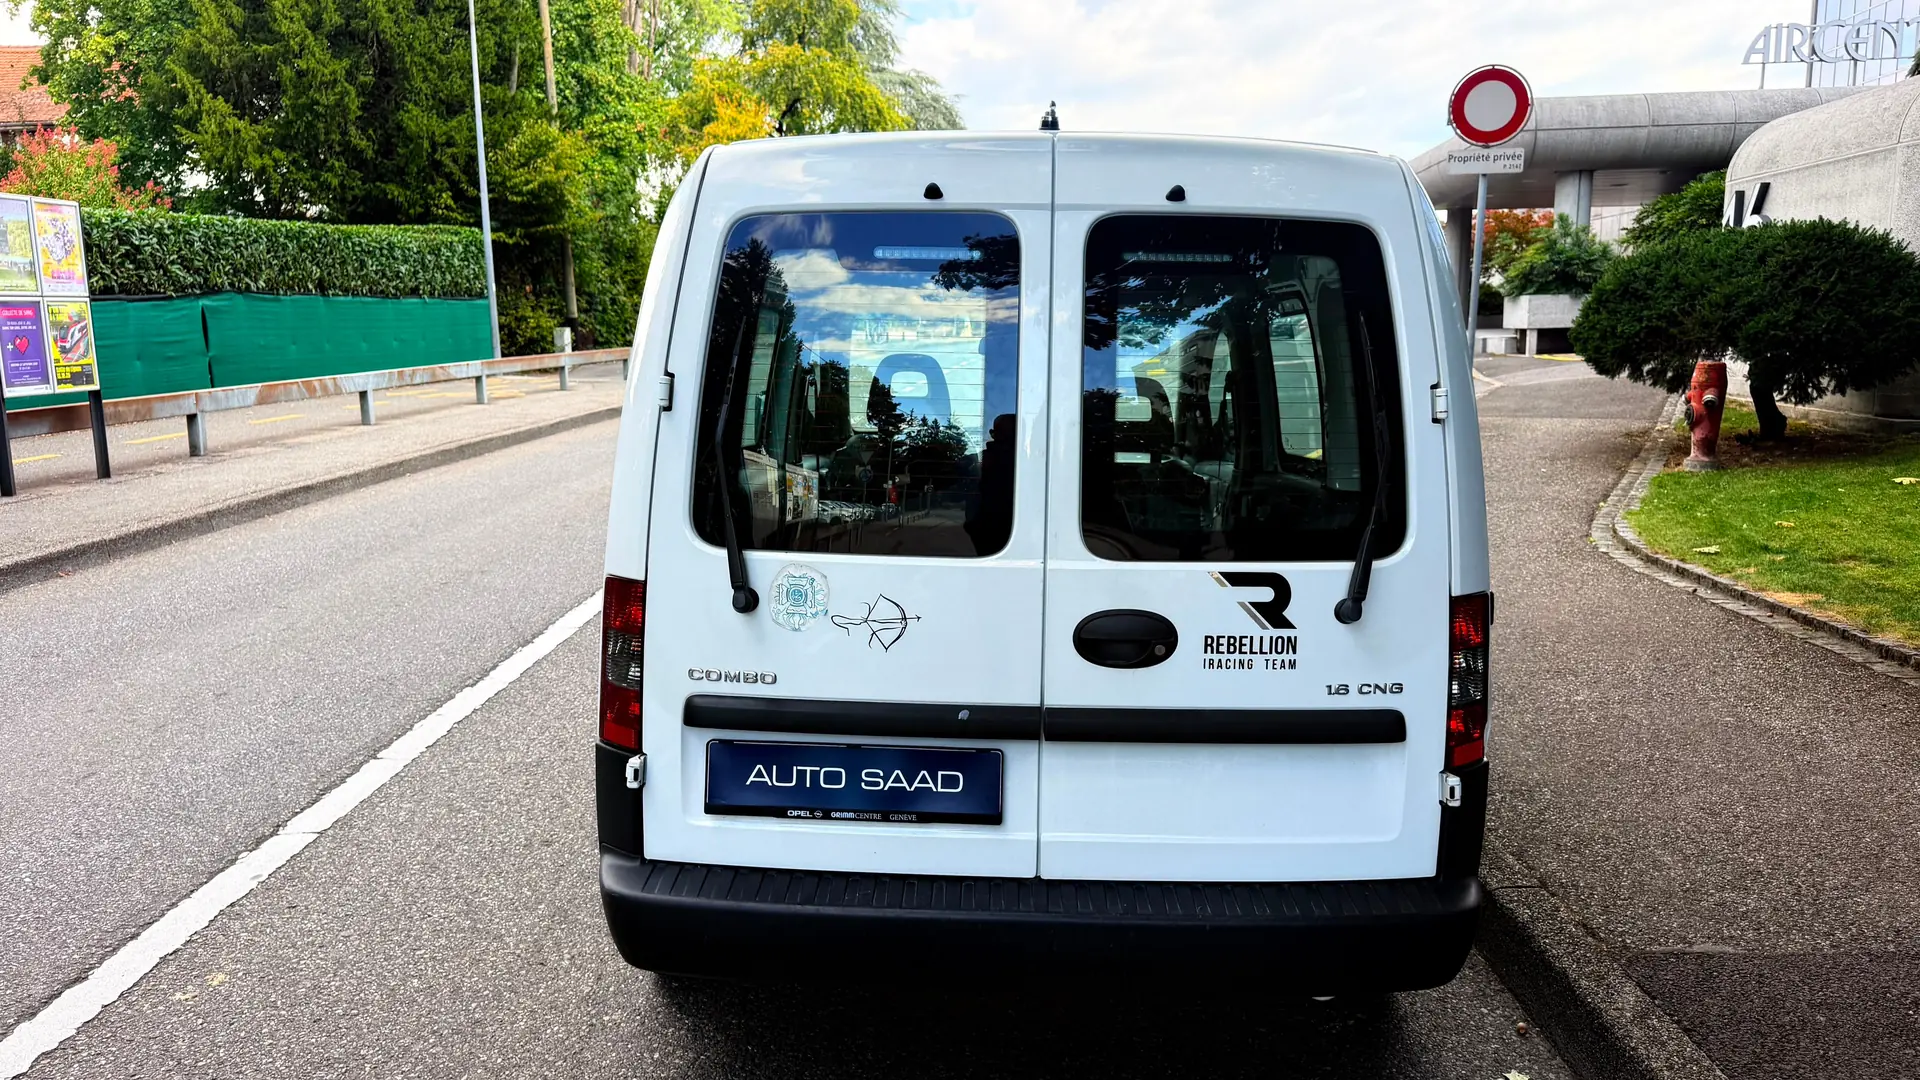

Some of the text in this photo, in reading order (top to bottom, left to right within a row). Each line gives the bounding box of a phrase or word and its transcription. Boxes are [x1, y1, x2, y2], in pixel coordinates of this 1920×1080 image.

[1448, 152, 1522, 164] Propriété privée
[1204, 635, 1298, 655] REBELLION
[1203, 658, 1297, 670] IRACING TEAM
[687, 667, 778, 685] COMBO
[1357, 682, 1404, 695] CNG
[745, 764, 964, 793] AUTO SAAD
[787, 809, 813, 817] OPEL
[889, 813, 917, 821] GENÈVE
